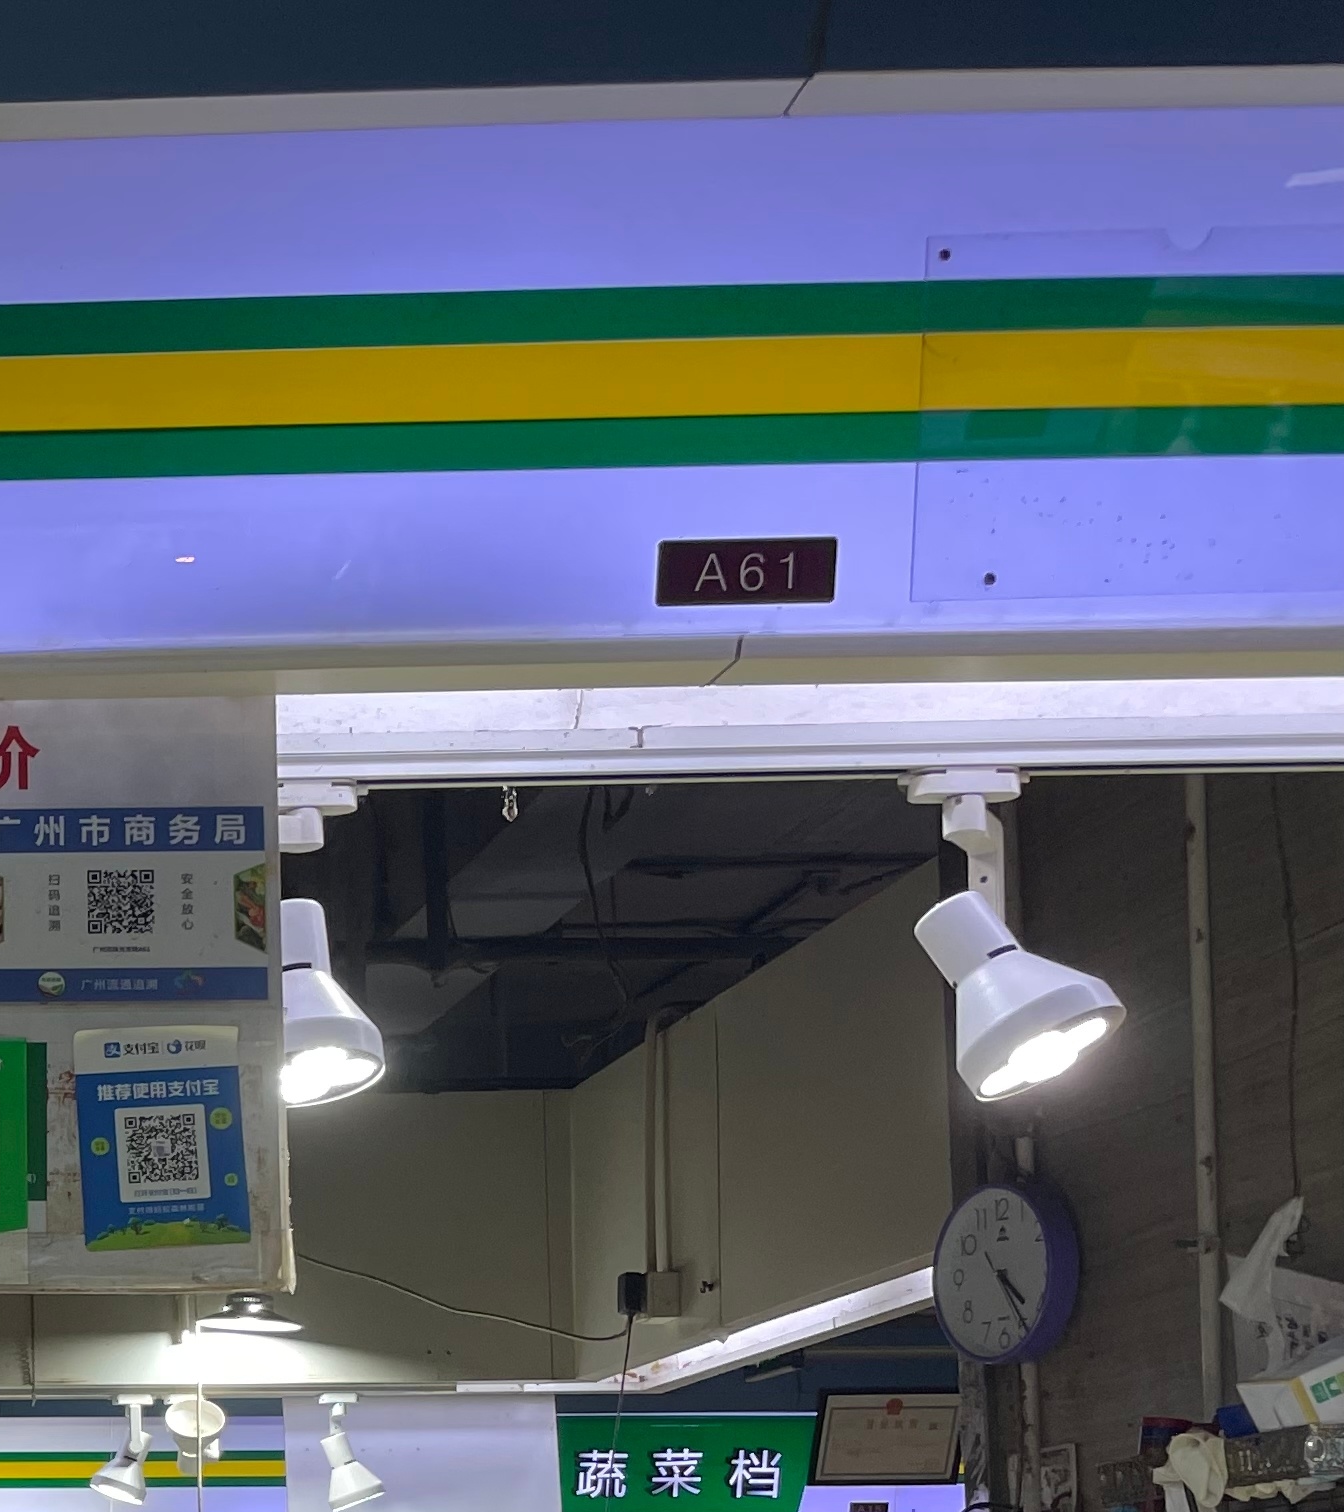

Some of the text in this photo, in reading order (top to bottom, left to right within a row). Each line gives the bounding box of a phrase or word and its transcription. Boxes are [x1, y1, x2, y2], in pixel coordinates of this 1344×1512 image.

[695, 552, 801, 592] A61
[180, 872, 194, 932] 安全放心
[123, 1041, 160, 1057] 支付宝
[97, 1078, 220, 1102] 推荐使用支付宝
[995, 1198, 1009, 1221] 12
[963, 1300, 973, 1324] 8
[981, 1321, 992, 1343] 7
[999, 1326, 1011, 1349] 6
[576, 1447, 783, 1498] 蔬菜档
